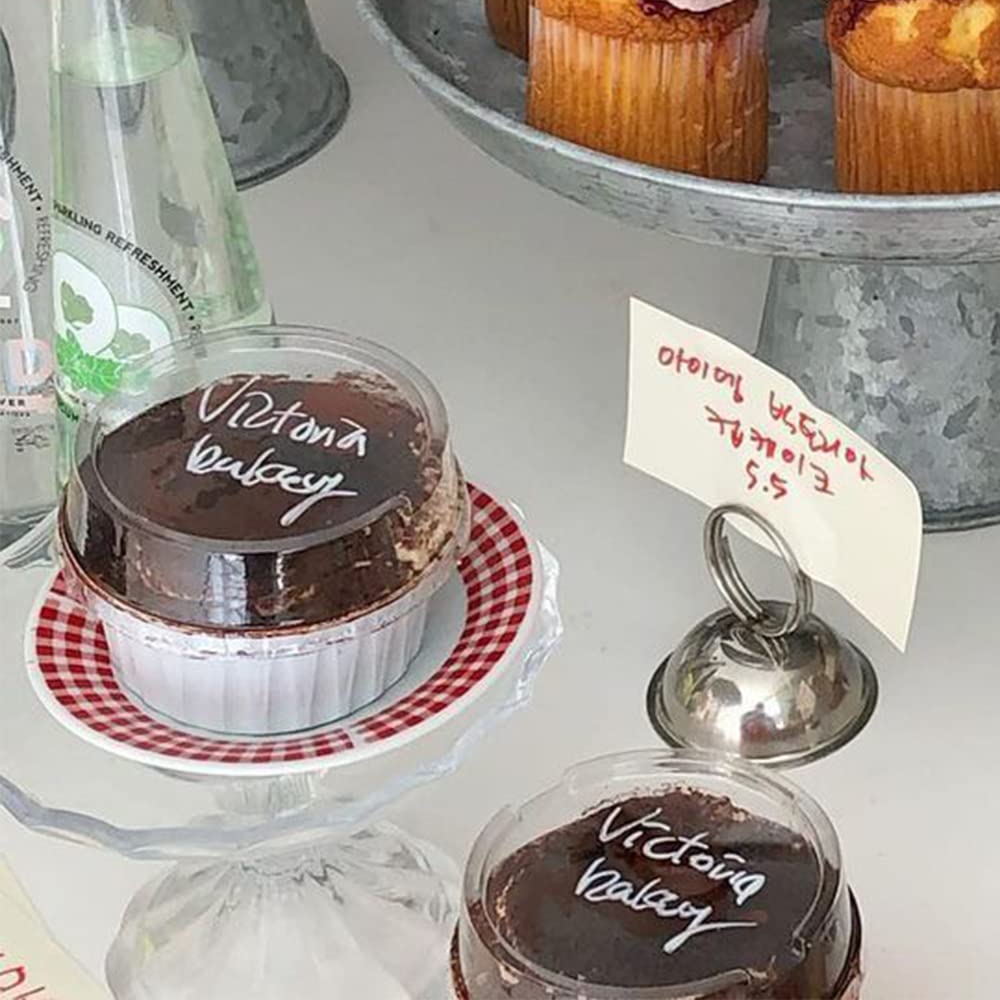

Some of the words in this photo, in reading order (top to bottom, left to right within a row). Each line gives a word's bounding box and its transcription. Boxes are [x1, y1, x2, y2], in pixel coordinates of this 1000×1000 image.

[104, 231, 195, 312] REFRESHMENT
[704, 405, 835, 495] 컵케이크
[745, 459, 788, 499] 5.5
[598, 807, 766, 905] Victoria
